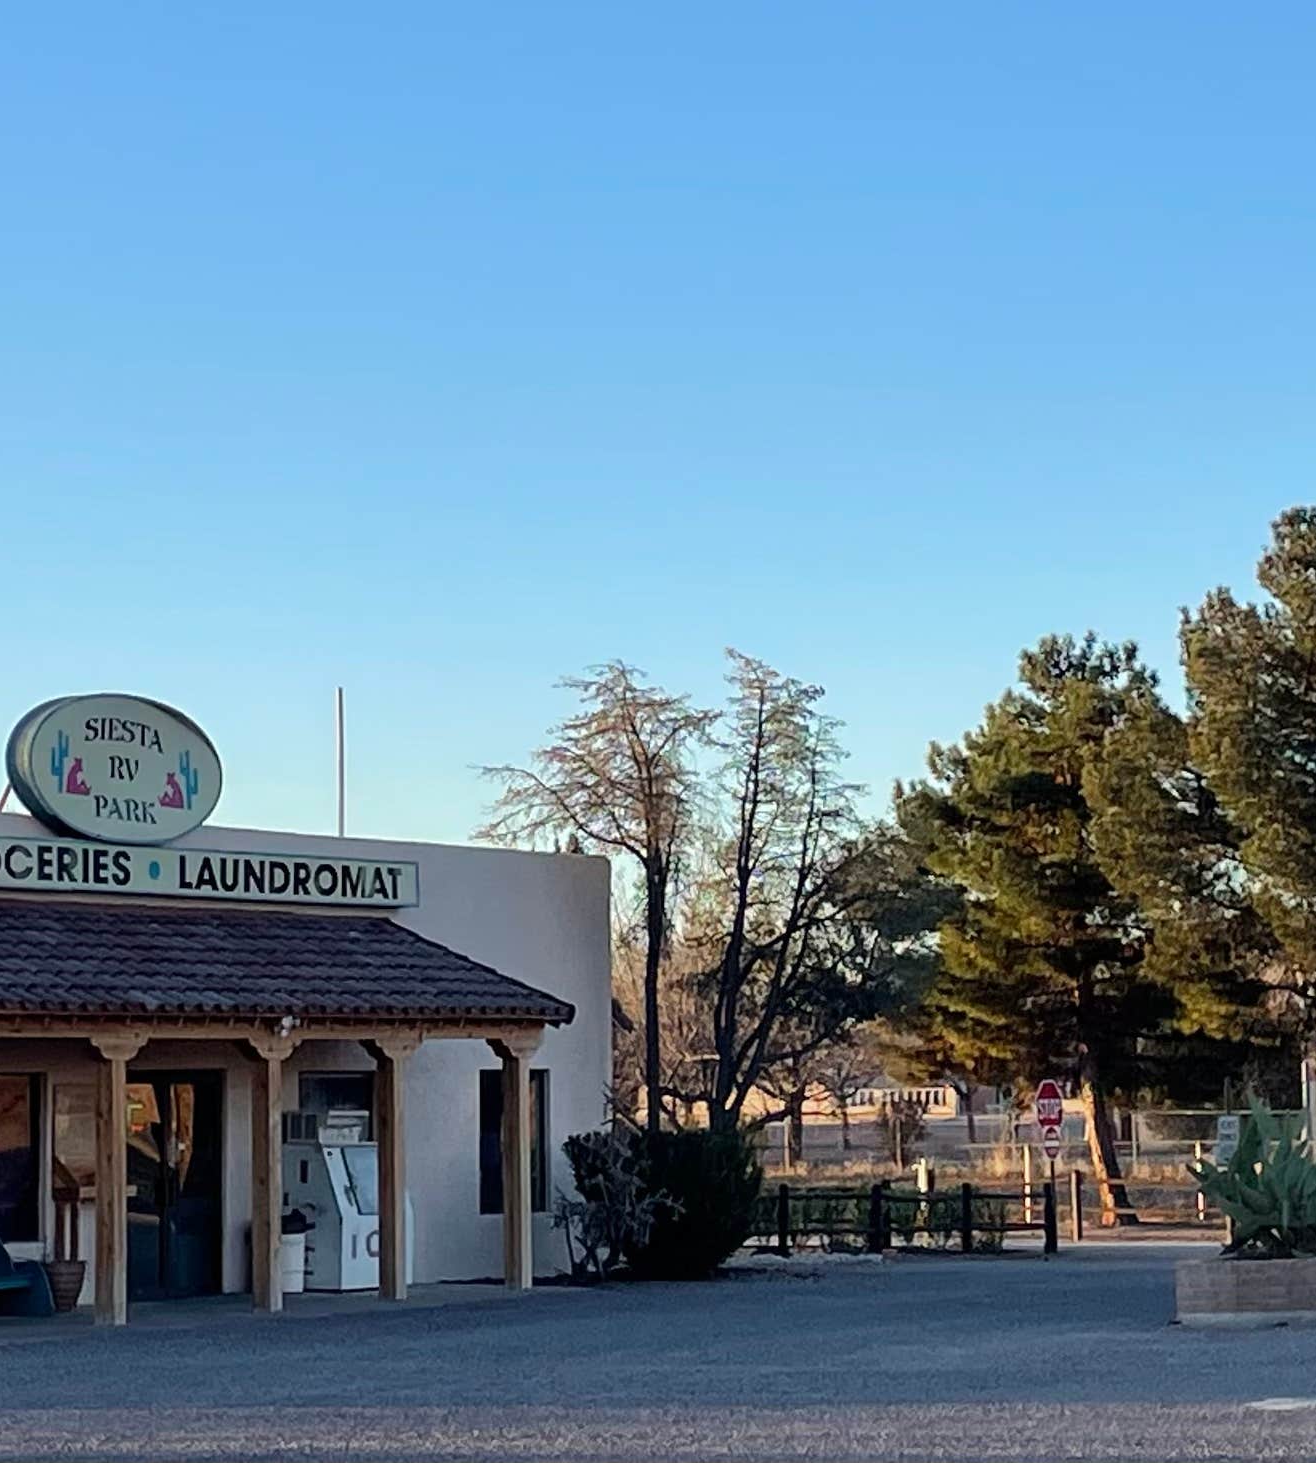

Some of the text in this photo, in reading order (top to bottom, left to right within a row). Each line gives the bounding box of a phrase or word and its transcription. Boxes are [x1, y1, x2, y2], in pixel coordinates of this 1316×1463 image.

[84, 717, 164, 754] SIESTA
[109, 755, 140, 782] RV
[94, 795, 158, 825] PARK
[179, 854, 403, 900] LAUNDROMAT
[1037, 1098, 1061, 1119] STOP
